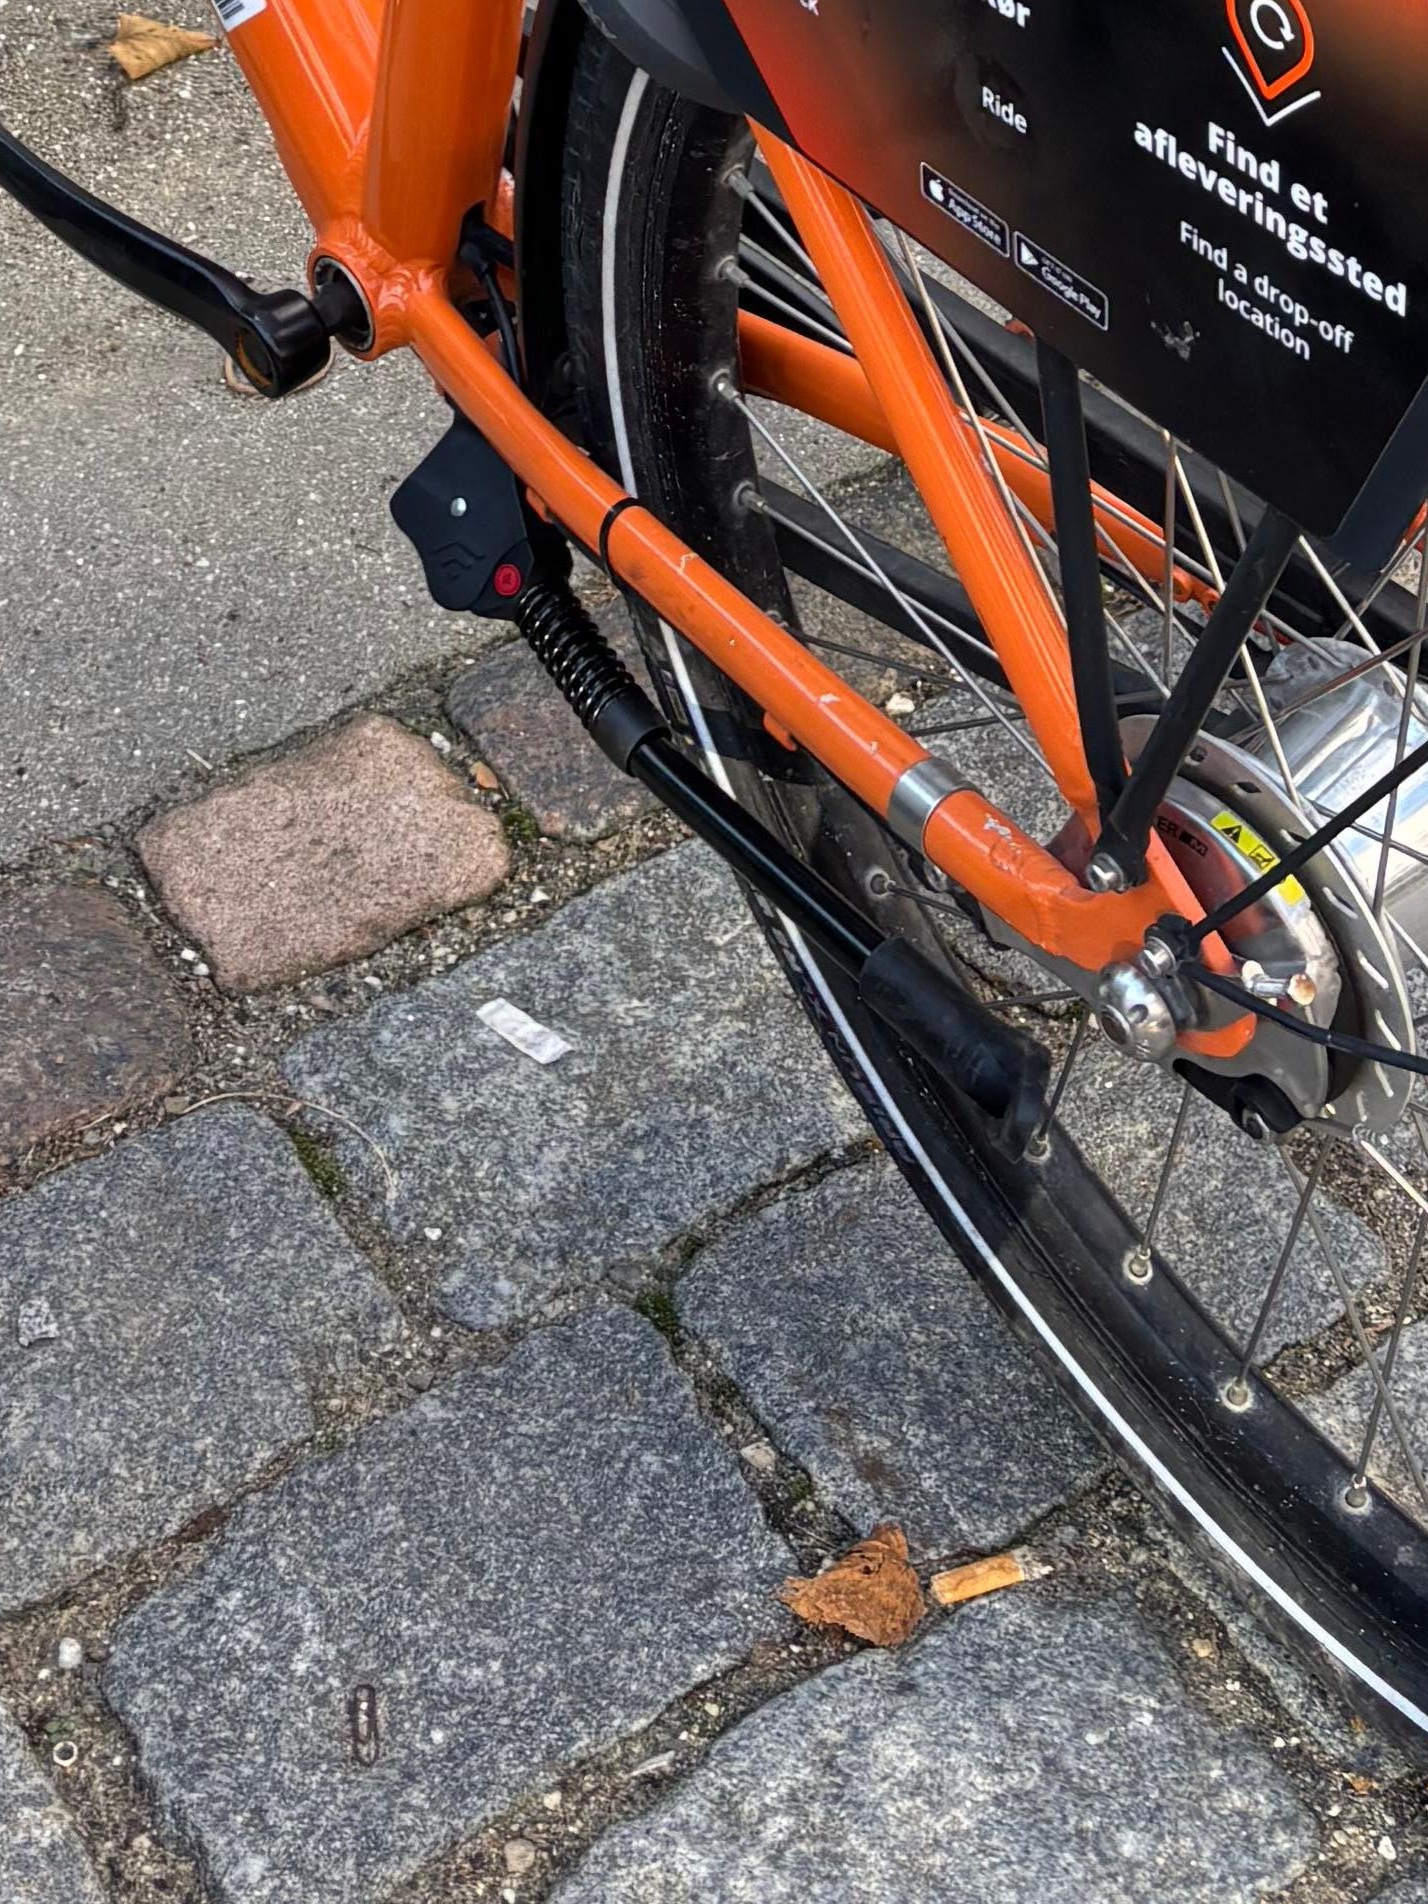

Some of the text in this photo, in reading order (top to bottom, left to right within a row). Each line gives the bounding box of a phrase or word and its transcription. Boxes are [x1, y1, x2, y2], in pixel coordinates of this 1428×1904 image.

[981, 85, 1028, 134] Ride
[1133, 120, 1408, 318] afleveringssted
[1208, 120, 1328, 226] Find et
[1180, 220, 1355, 354] Find a drop-off
[1217, 277, 1311, 361] location
